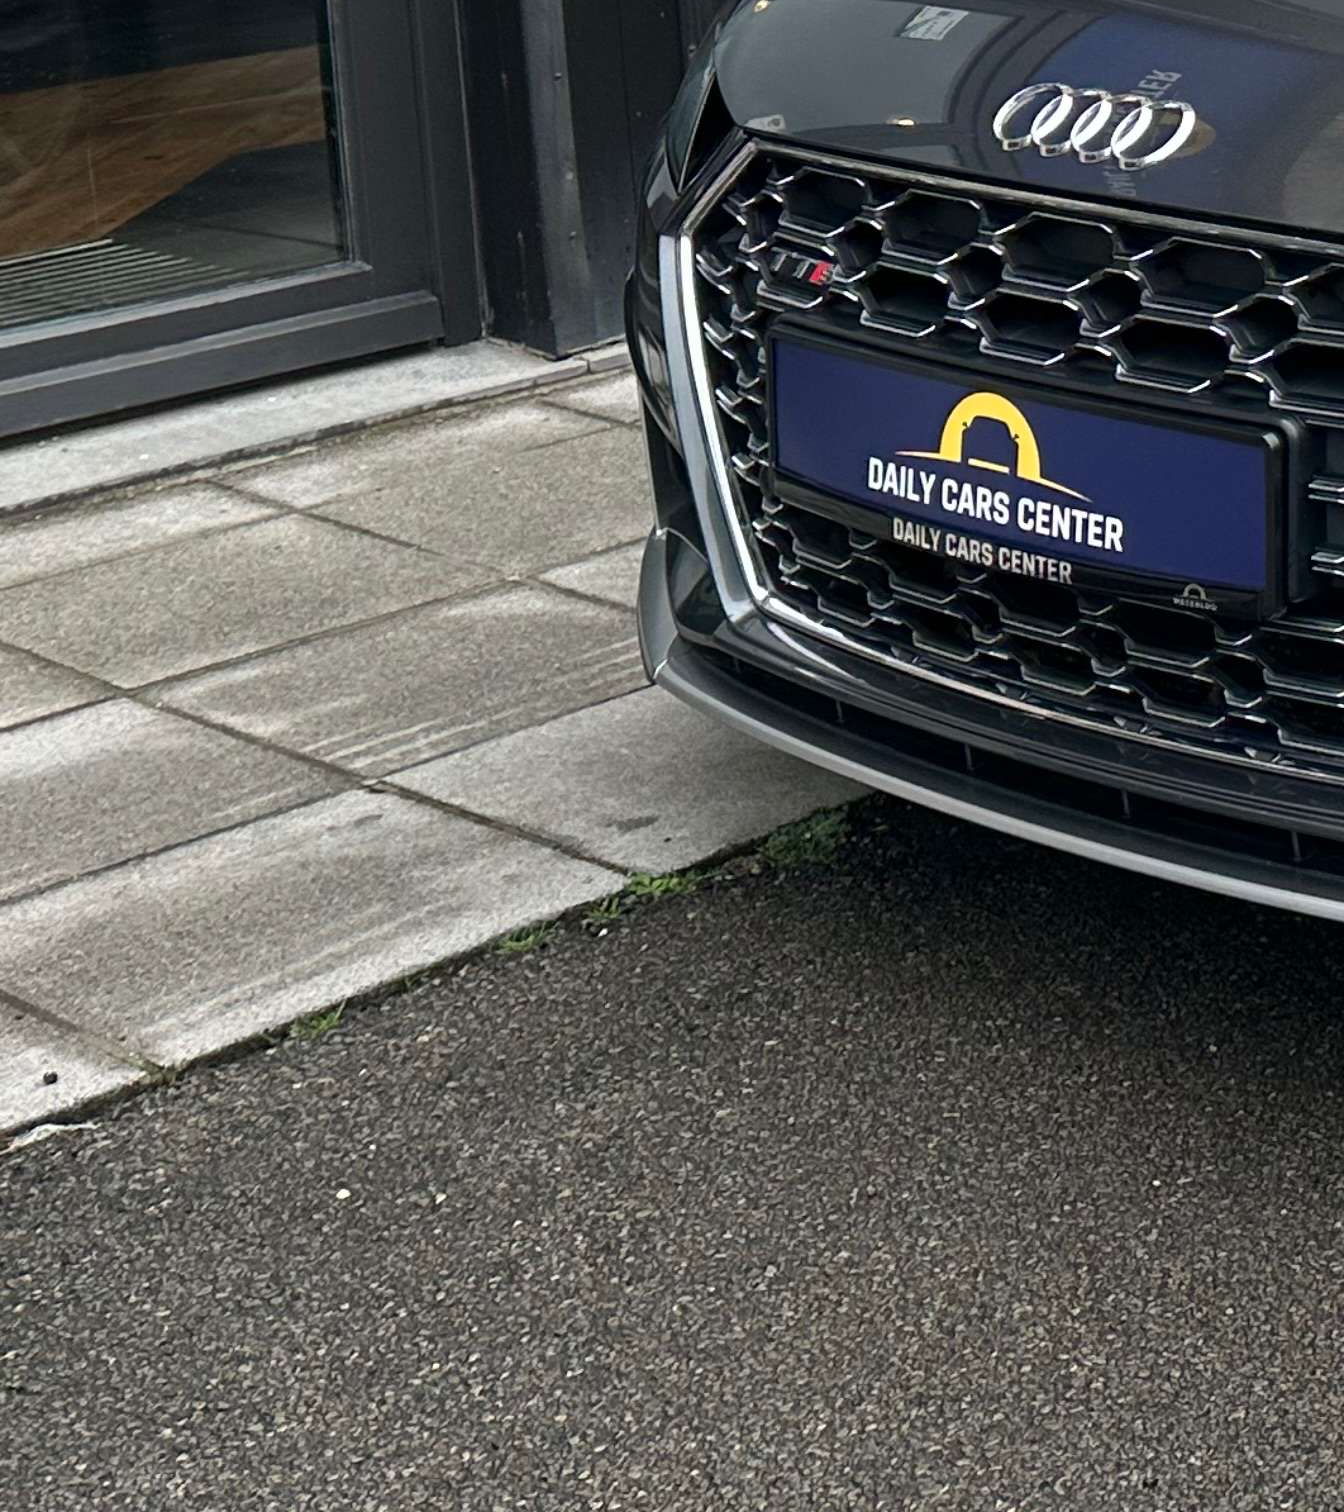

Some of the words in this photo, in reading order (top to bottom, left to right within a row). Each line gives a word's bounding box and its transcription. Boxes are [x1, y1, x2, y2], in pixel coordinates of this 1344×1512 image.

[868, 457, 936, 505] DAILY
[942, 478, 1009, 525] CARS
[1018, 498, 1124, 552] CENTER
[892, 517, 941, 551] DAILY
[945, 533, 993, 568] CARS
[998, 547, 1072, 586] CENTER
